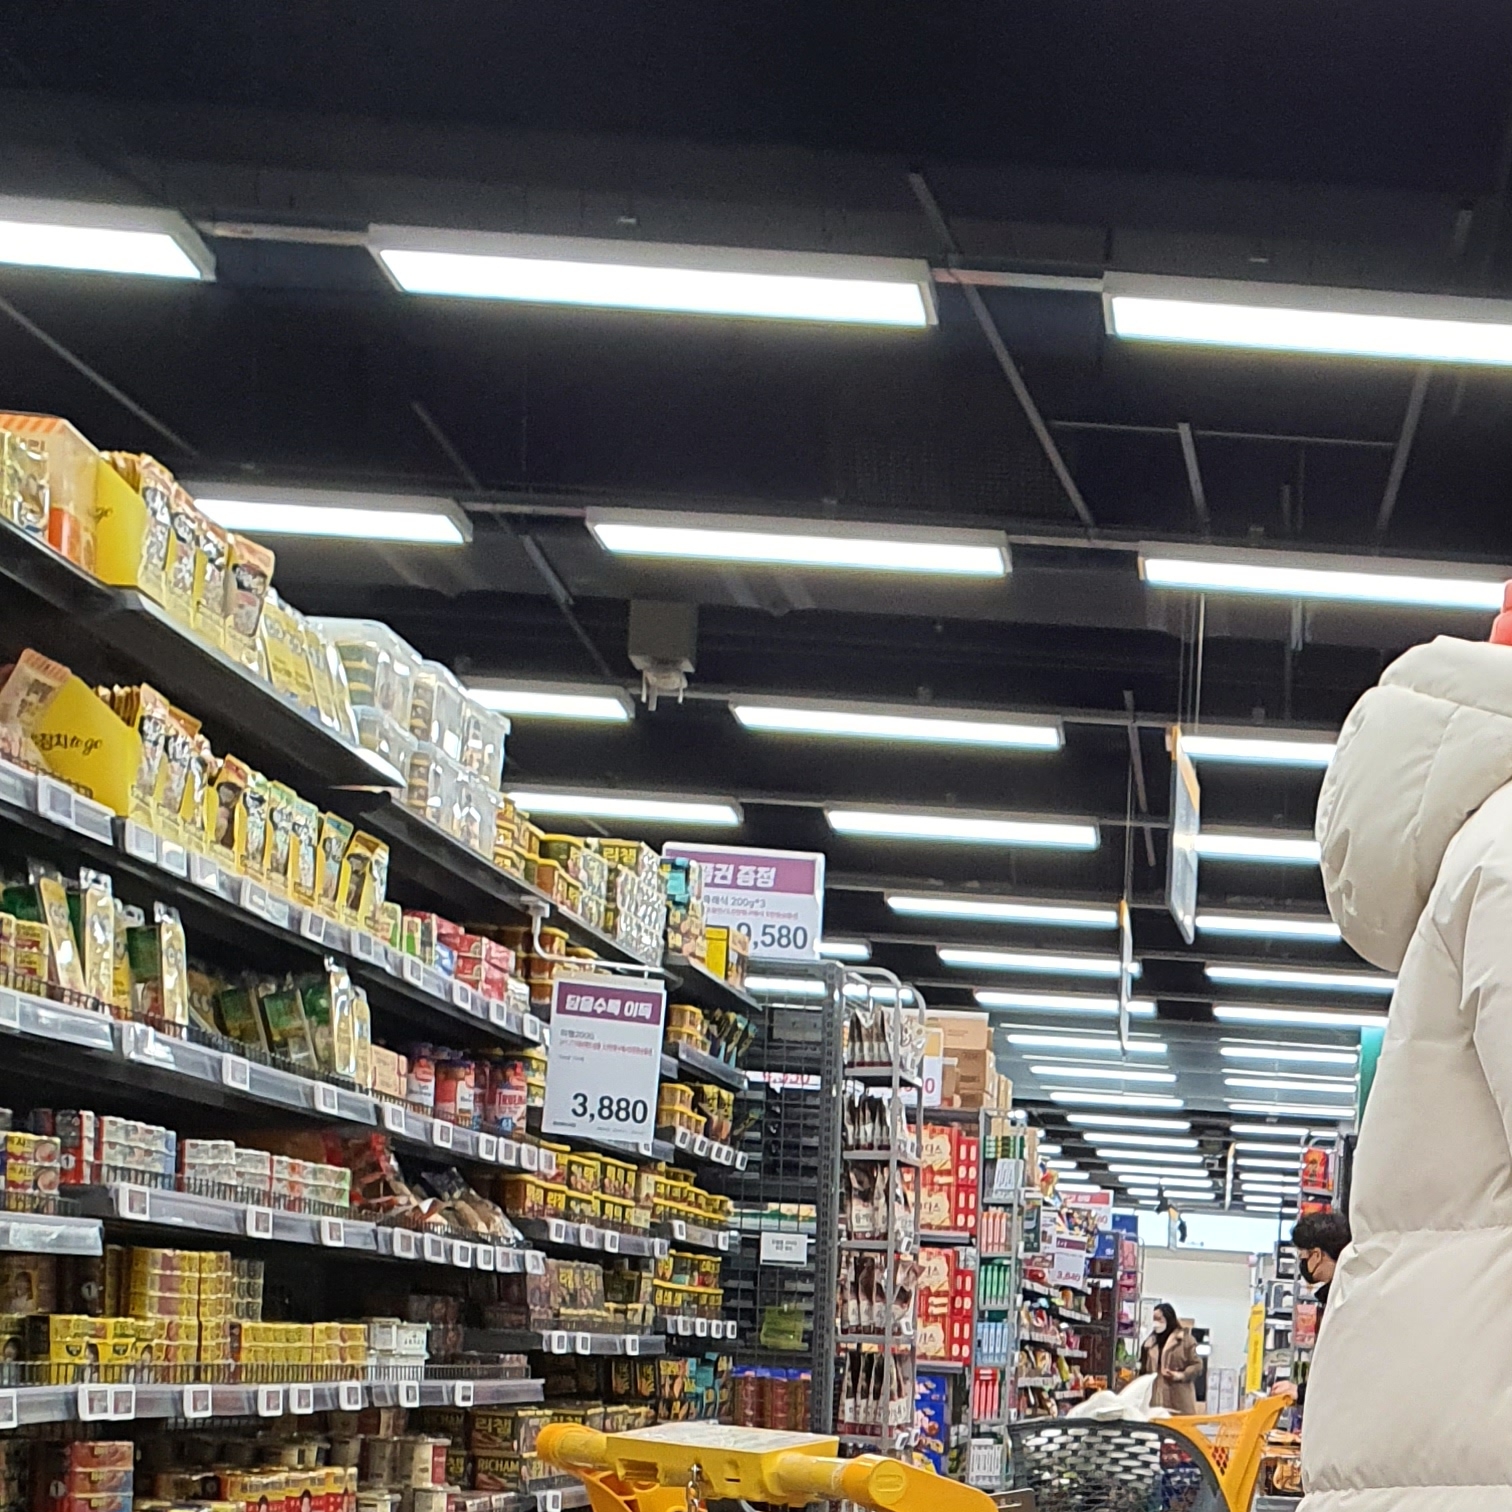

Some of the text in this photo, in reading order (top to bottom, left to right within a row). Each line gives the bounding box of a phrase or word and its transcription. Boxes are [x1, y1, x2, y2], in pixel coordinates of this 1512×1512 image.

[736, 864, 776, 888] 증정
[736, 922, 808, 951] 9,580
[571, 1092, 649, 1124] 3,880
[475, 1416, 512, 1437] 리챔
[477, 1459, 520, 1473] RICHAM
